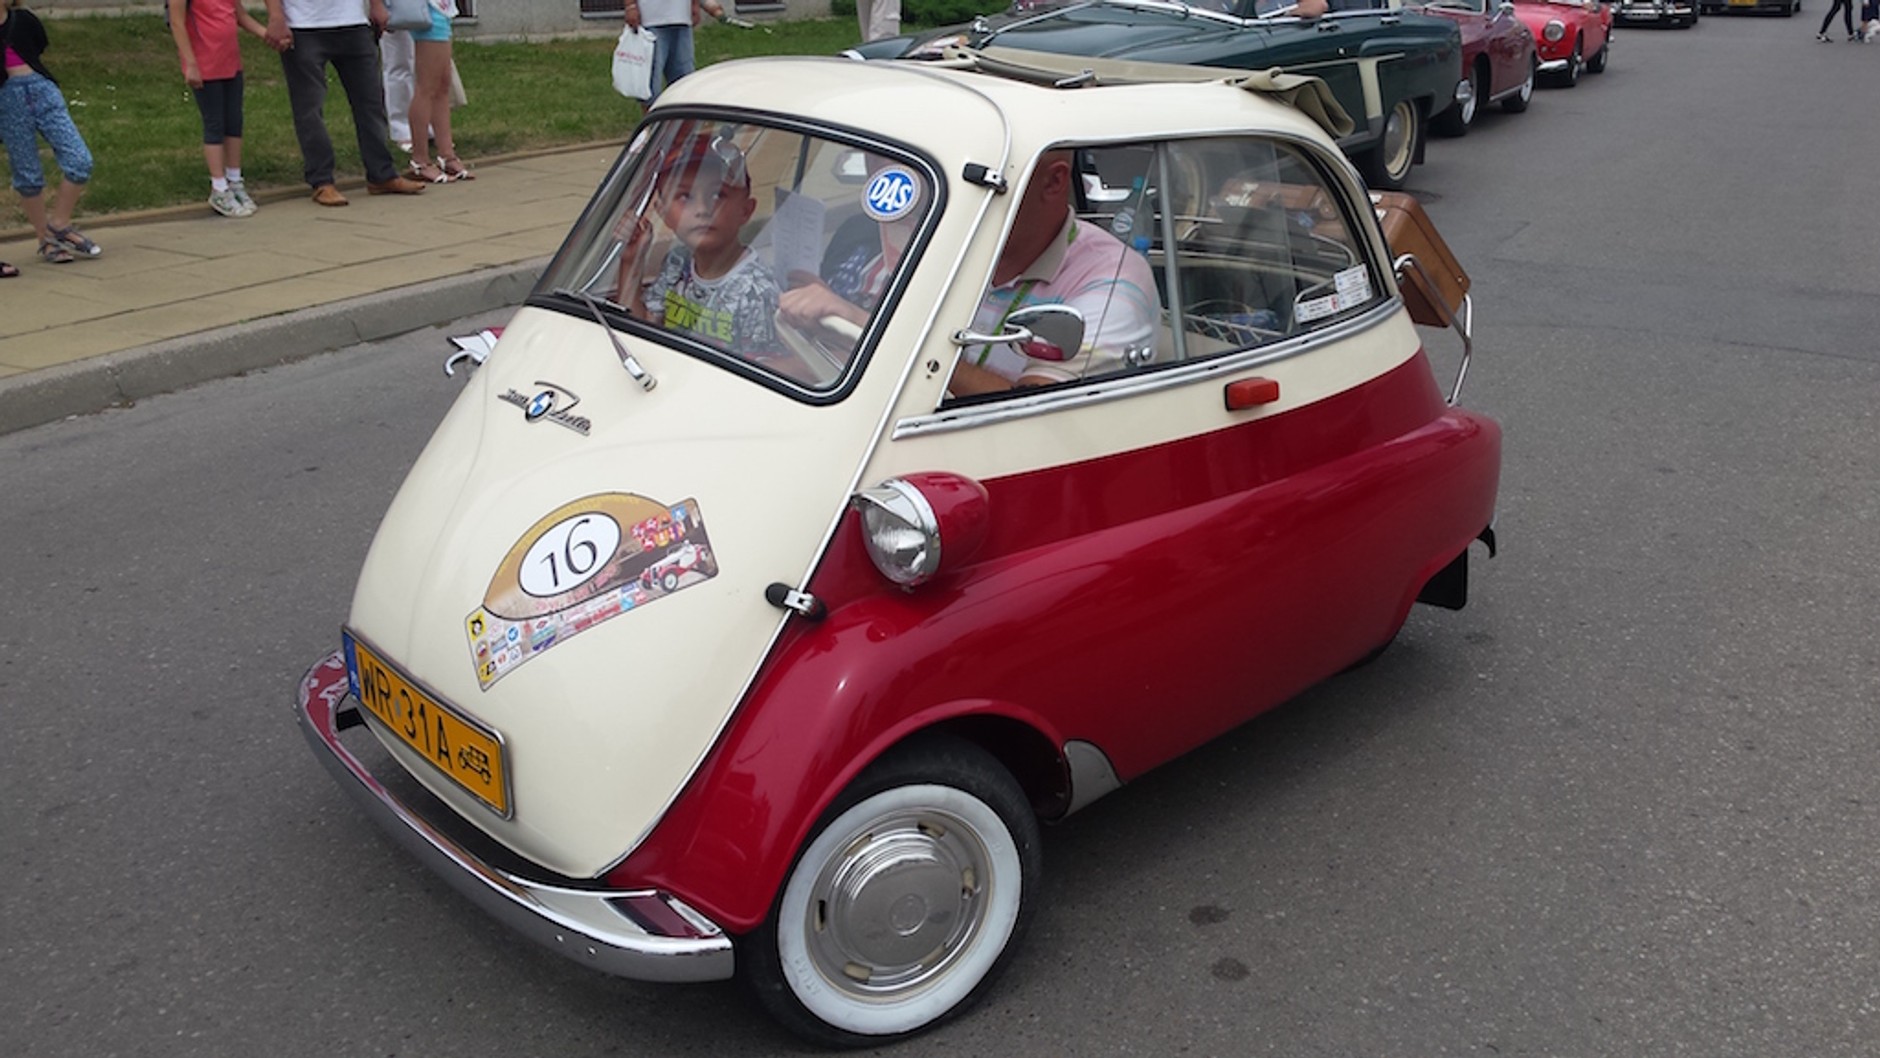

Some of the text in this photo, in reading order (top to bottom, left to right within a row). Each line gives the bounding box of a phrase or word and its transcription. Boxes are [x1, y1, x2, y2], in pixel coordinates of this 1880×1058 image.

[870, 177, 912, 211] DAS
[540, 518, 597, 587] 16
[359, 651, 453, 769] WR 31A
